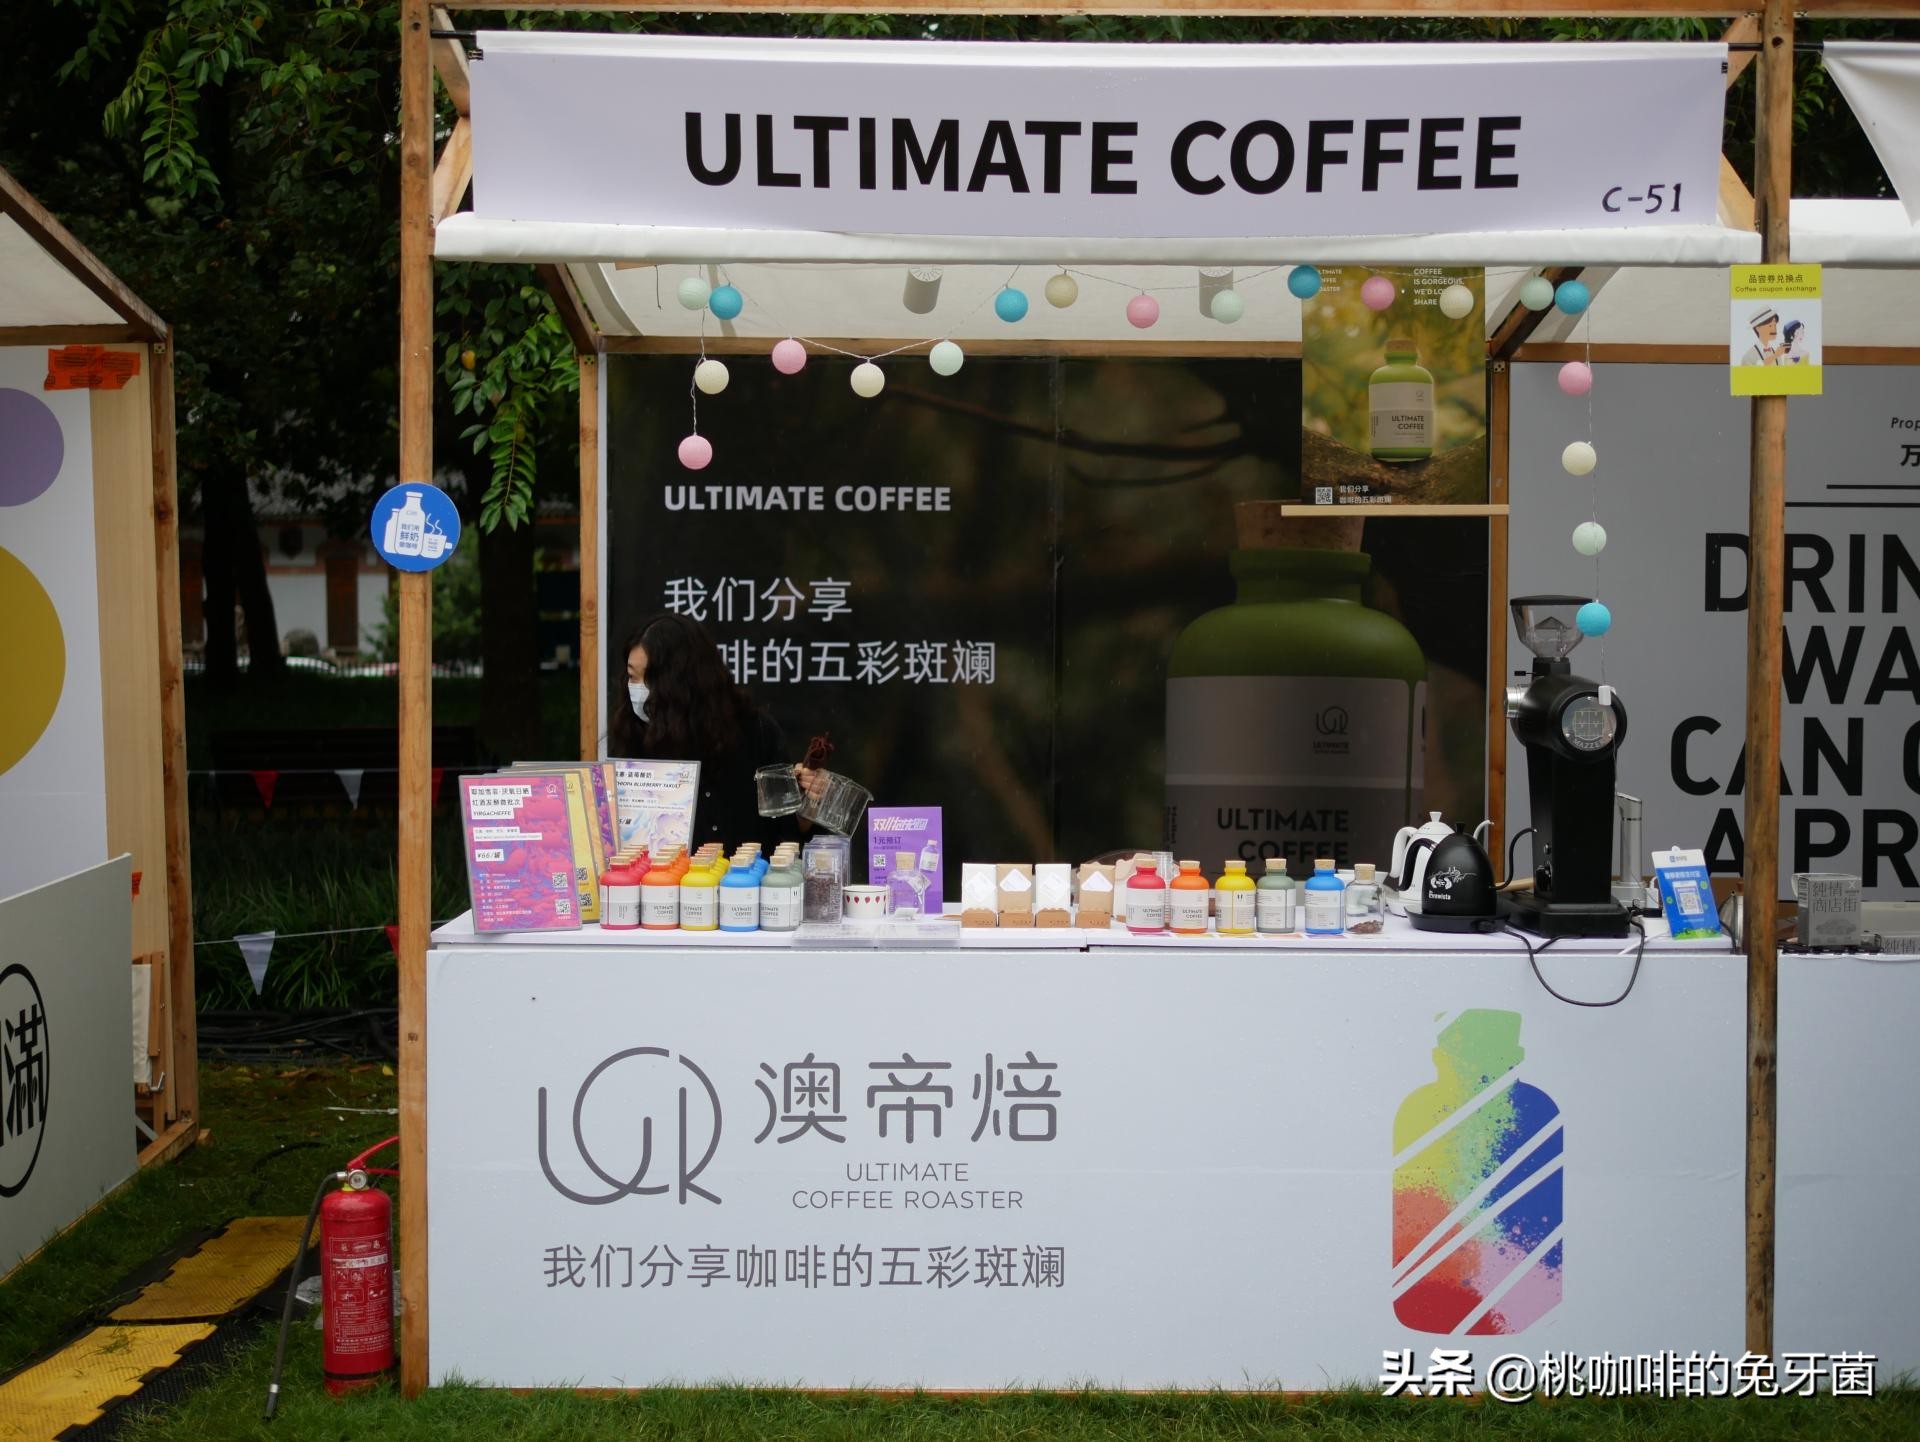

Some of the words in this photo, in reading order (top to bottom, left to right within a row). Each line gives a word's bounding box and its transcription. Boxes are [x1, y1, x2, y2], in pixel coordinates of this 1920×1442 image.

[686, 112, 1137, 194] ULTIMATE
[1171, 117, 1521, 195] COFFEE
[1603, 184, 1682, 213] C-51
[665, 486, 824, 510] ULTIMATE
[836, 486, 951, 511] COFFEE
[664, 577, 852, 622] 我们分享
[1217, 808, 1349, 832] ULTIMATE
[1238, 840, 1349, 864] COFFEE
[755, 1051, 1062, 1144] 澳帝焙
[847, 1163, 968, 1181] ULTIMATE
[793, 1191, 893, 1208] COFFEE
[905, 1191, 1023, 1208] ROASTER
[544, 1244, 1065, 1288] 我们分享咖啡的五彩斑斓
